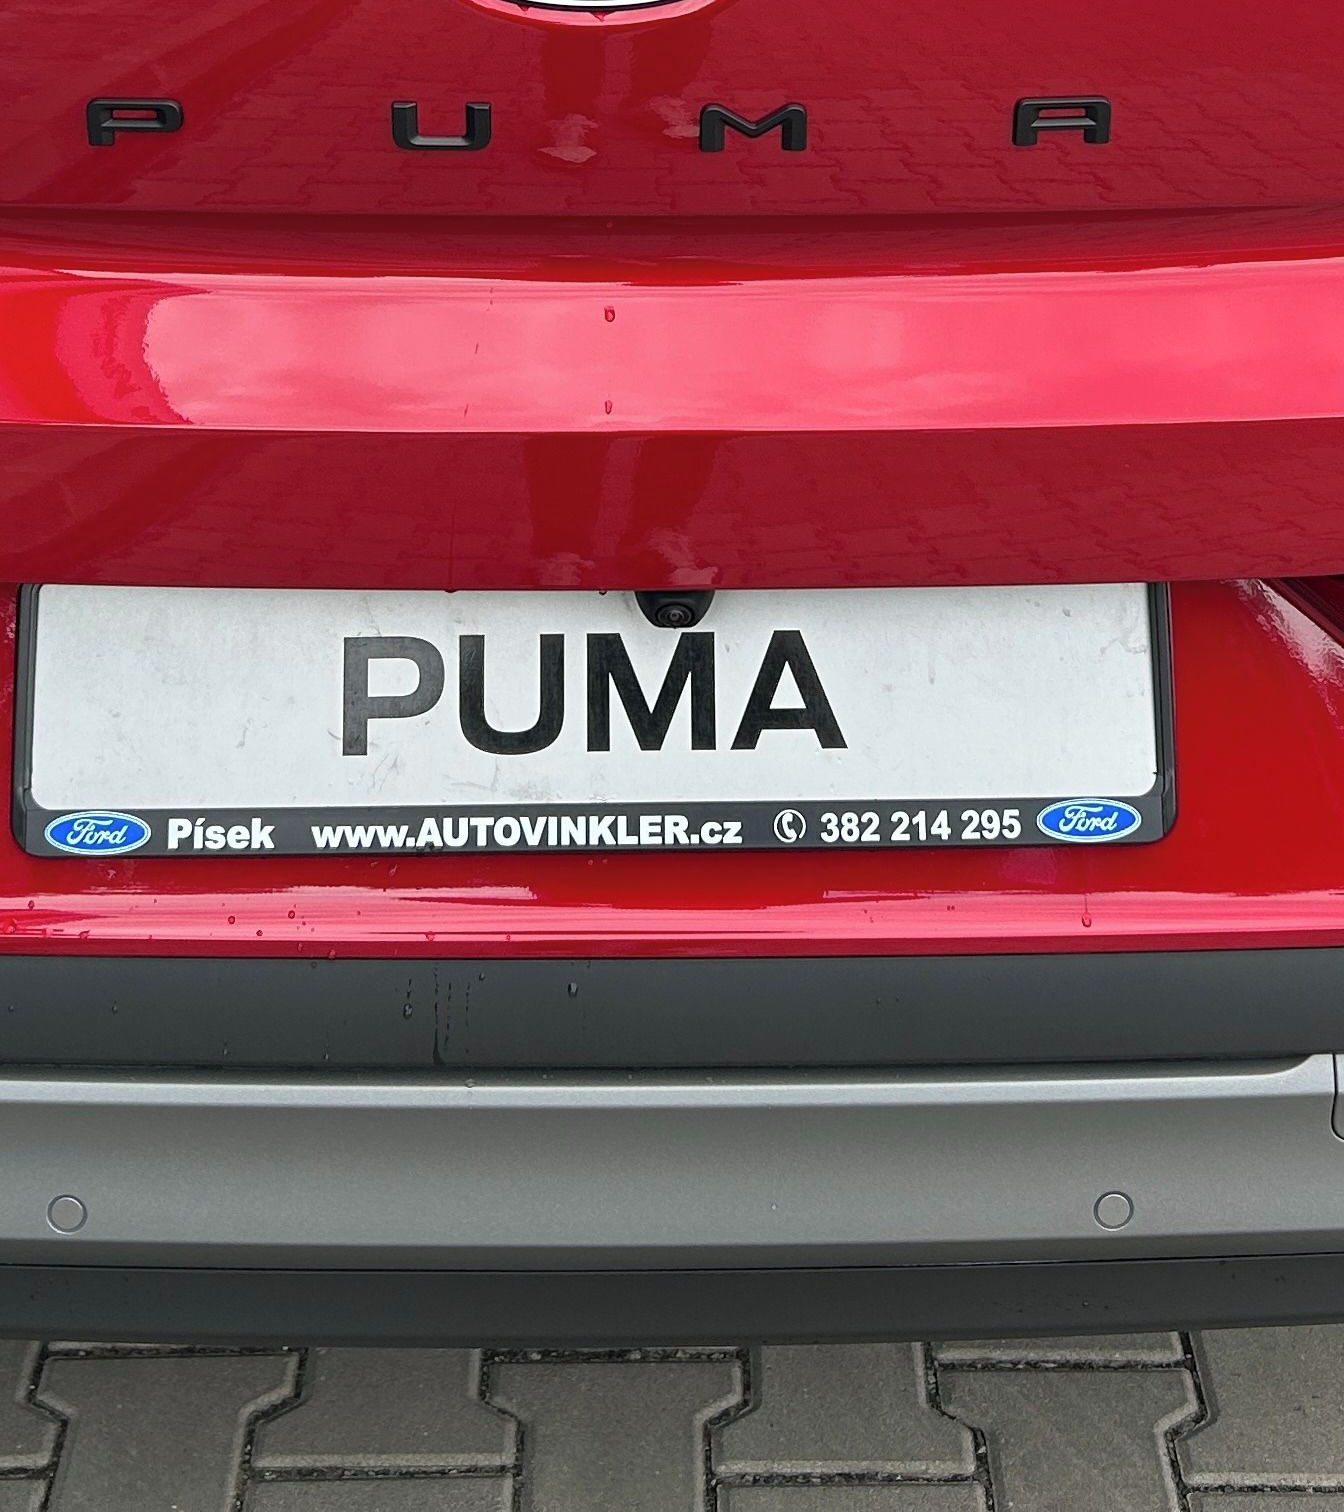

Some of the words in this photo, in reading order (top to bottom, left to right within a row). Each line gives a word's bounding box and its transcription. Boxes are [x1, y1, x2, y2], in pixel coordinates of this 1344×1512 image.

[86, 94, 1113, 153] PUMA
[341, 629, 847, 757] PUMA
[65, 813, 128, 847] Ford
[166, 816, 275, 850] Písek
[311, 811, 744, 849] www.AUTOVINKLER.cz
[819, 811, 882, 843] 382
[889, 809, 952, 842] 214
[960, 808, 1023, 840] 295
[1058, 804, 1119, 833] Ford
